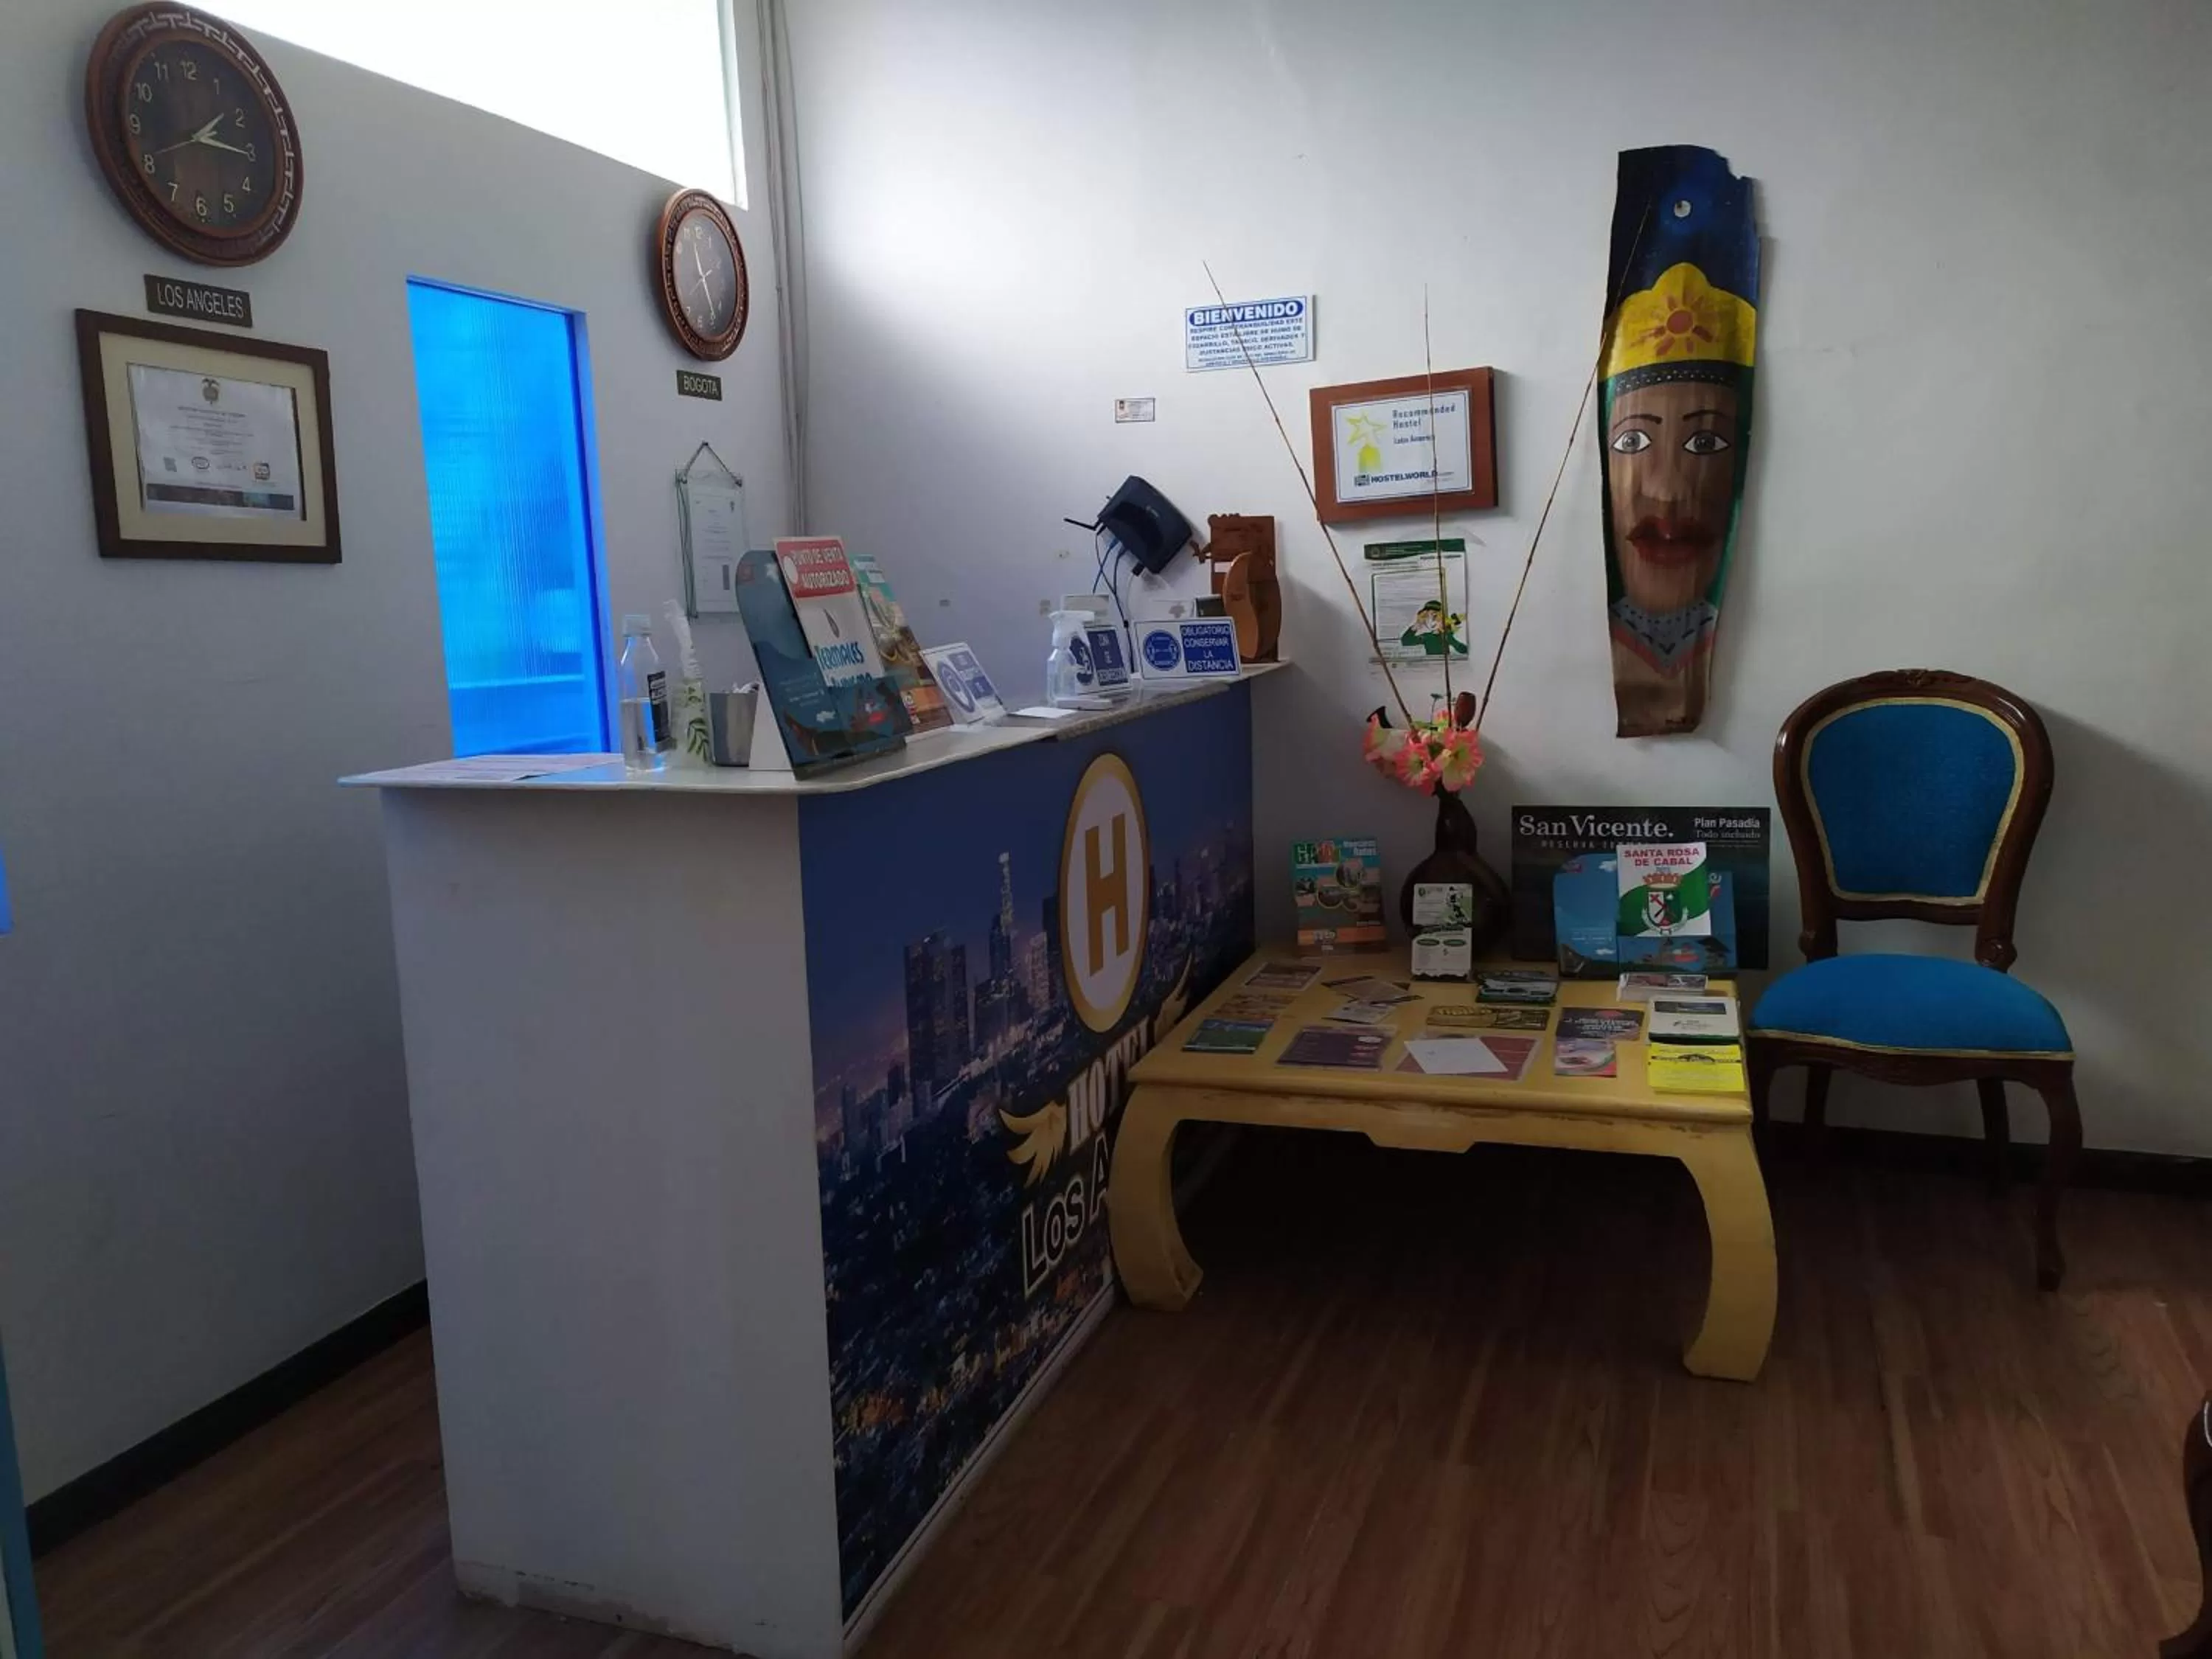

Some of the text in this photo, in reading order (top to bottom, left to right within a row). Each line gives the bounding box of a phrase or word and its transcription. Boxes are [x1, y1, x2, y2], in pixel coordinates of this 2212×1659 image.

[154, 61, 169, 83] 11
[181, 60, 198, 80] 12
[136, 83, 152, 102] 10
[214, 77, 219, 95] 1
[129, 114, 141, 135] 9
[235, 108, 246, 128] 2
[144, 154, 155, 175] 8
[168, 182, 178, 201] 7
[242, 176, 251, 192] 4
[195, 196, 207, 217] 6
[223, 194, 235, 213] 5
[157, 283, 244, 319] LOS ANGELES
[1194, 302, 1298, 325] BIENVENIDO
[684, 375, 717, 394] BOGOTA
[1393, 417, 1422, 429] Hostel
[801, 569, 850, 588] AUTORIZADO
[1181, 626, 1231, 635] OBLIGATORIO
[1183, 638, 1230, 647] CONSERVAR
[1203, 649, 1214, 658] LA
[1188, 660, 1234, 670] DISTANCIA
[1519, 814, 1568, 835] San
[1694, 817, 1717, 828] Plan
[1624, 847, 1700, 858] SANTA ROSA
[1635, 858, 1693, 866] DE CABAL
[1085, 813, 1129, 978] H
